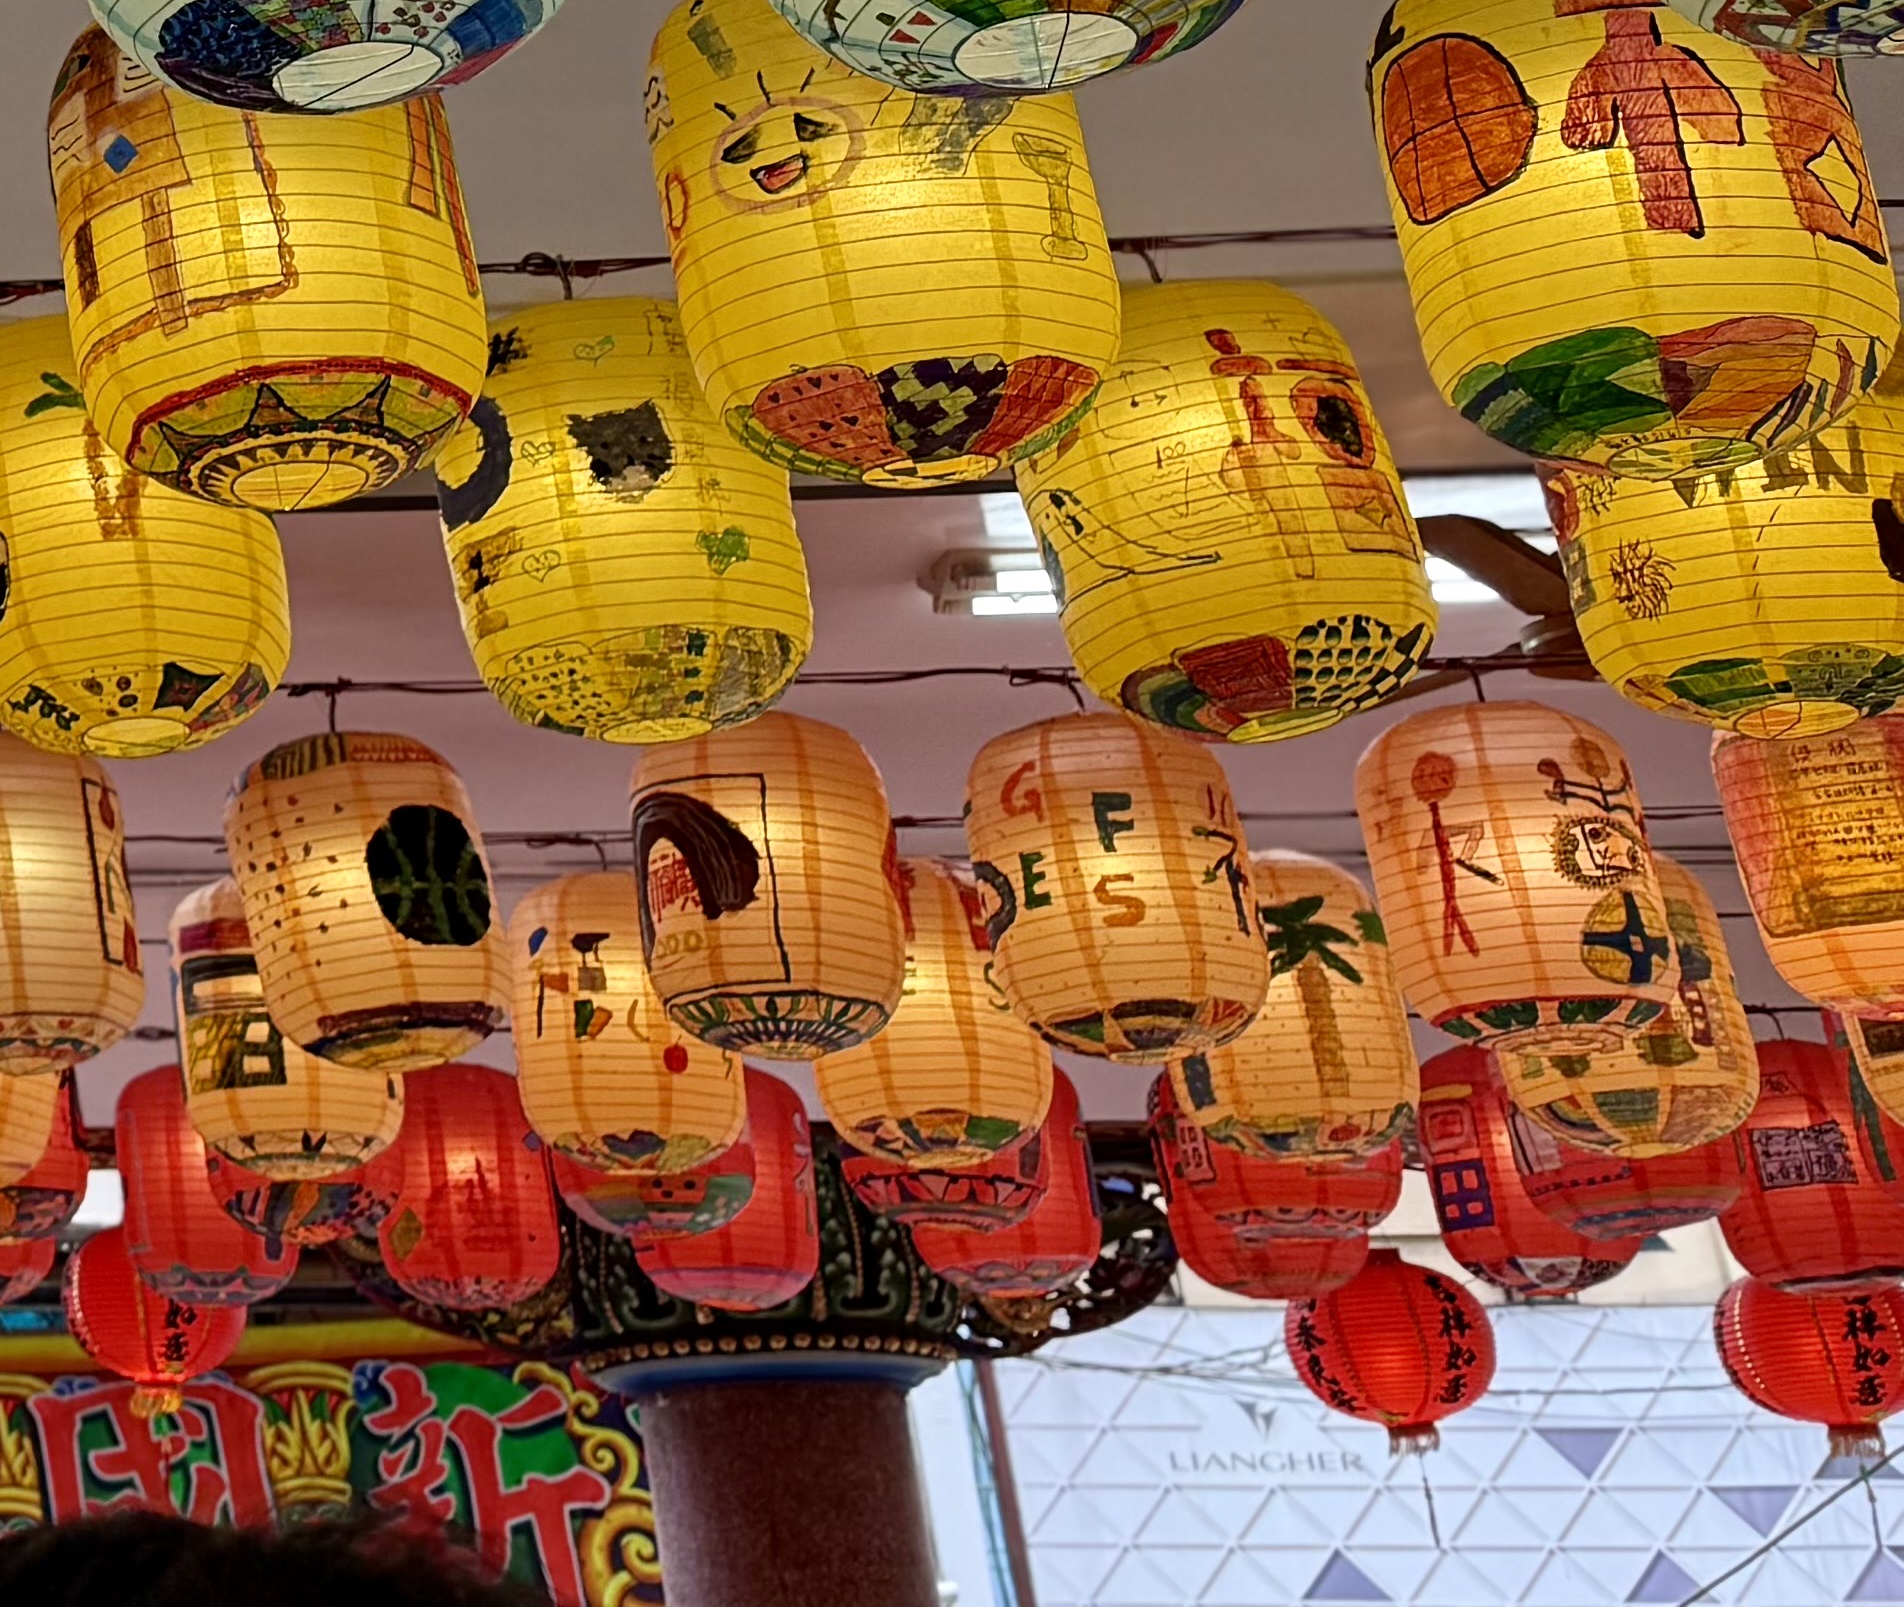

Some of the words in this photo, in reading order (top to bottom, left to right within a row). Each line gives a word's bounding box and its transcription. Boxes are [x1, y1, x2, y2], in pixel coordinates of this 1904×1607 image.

[1424, 1272, 1478, 1406] 吉祥如意
[1169, 1450, 1365, 1472] LIANGHER
